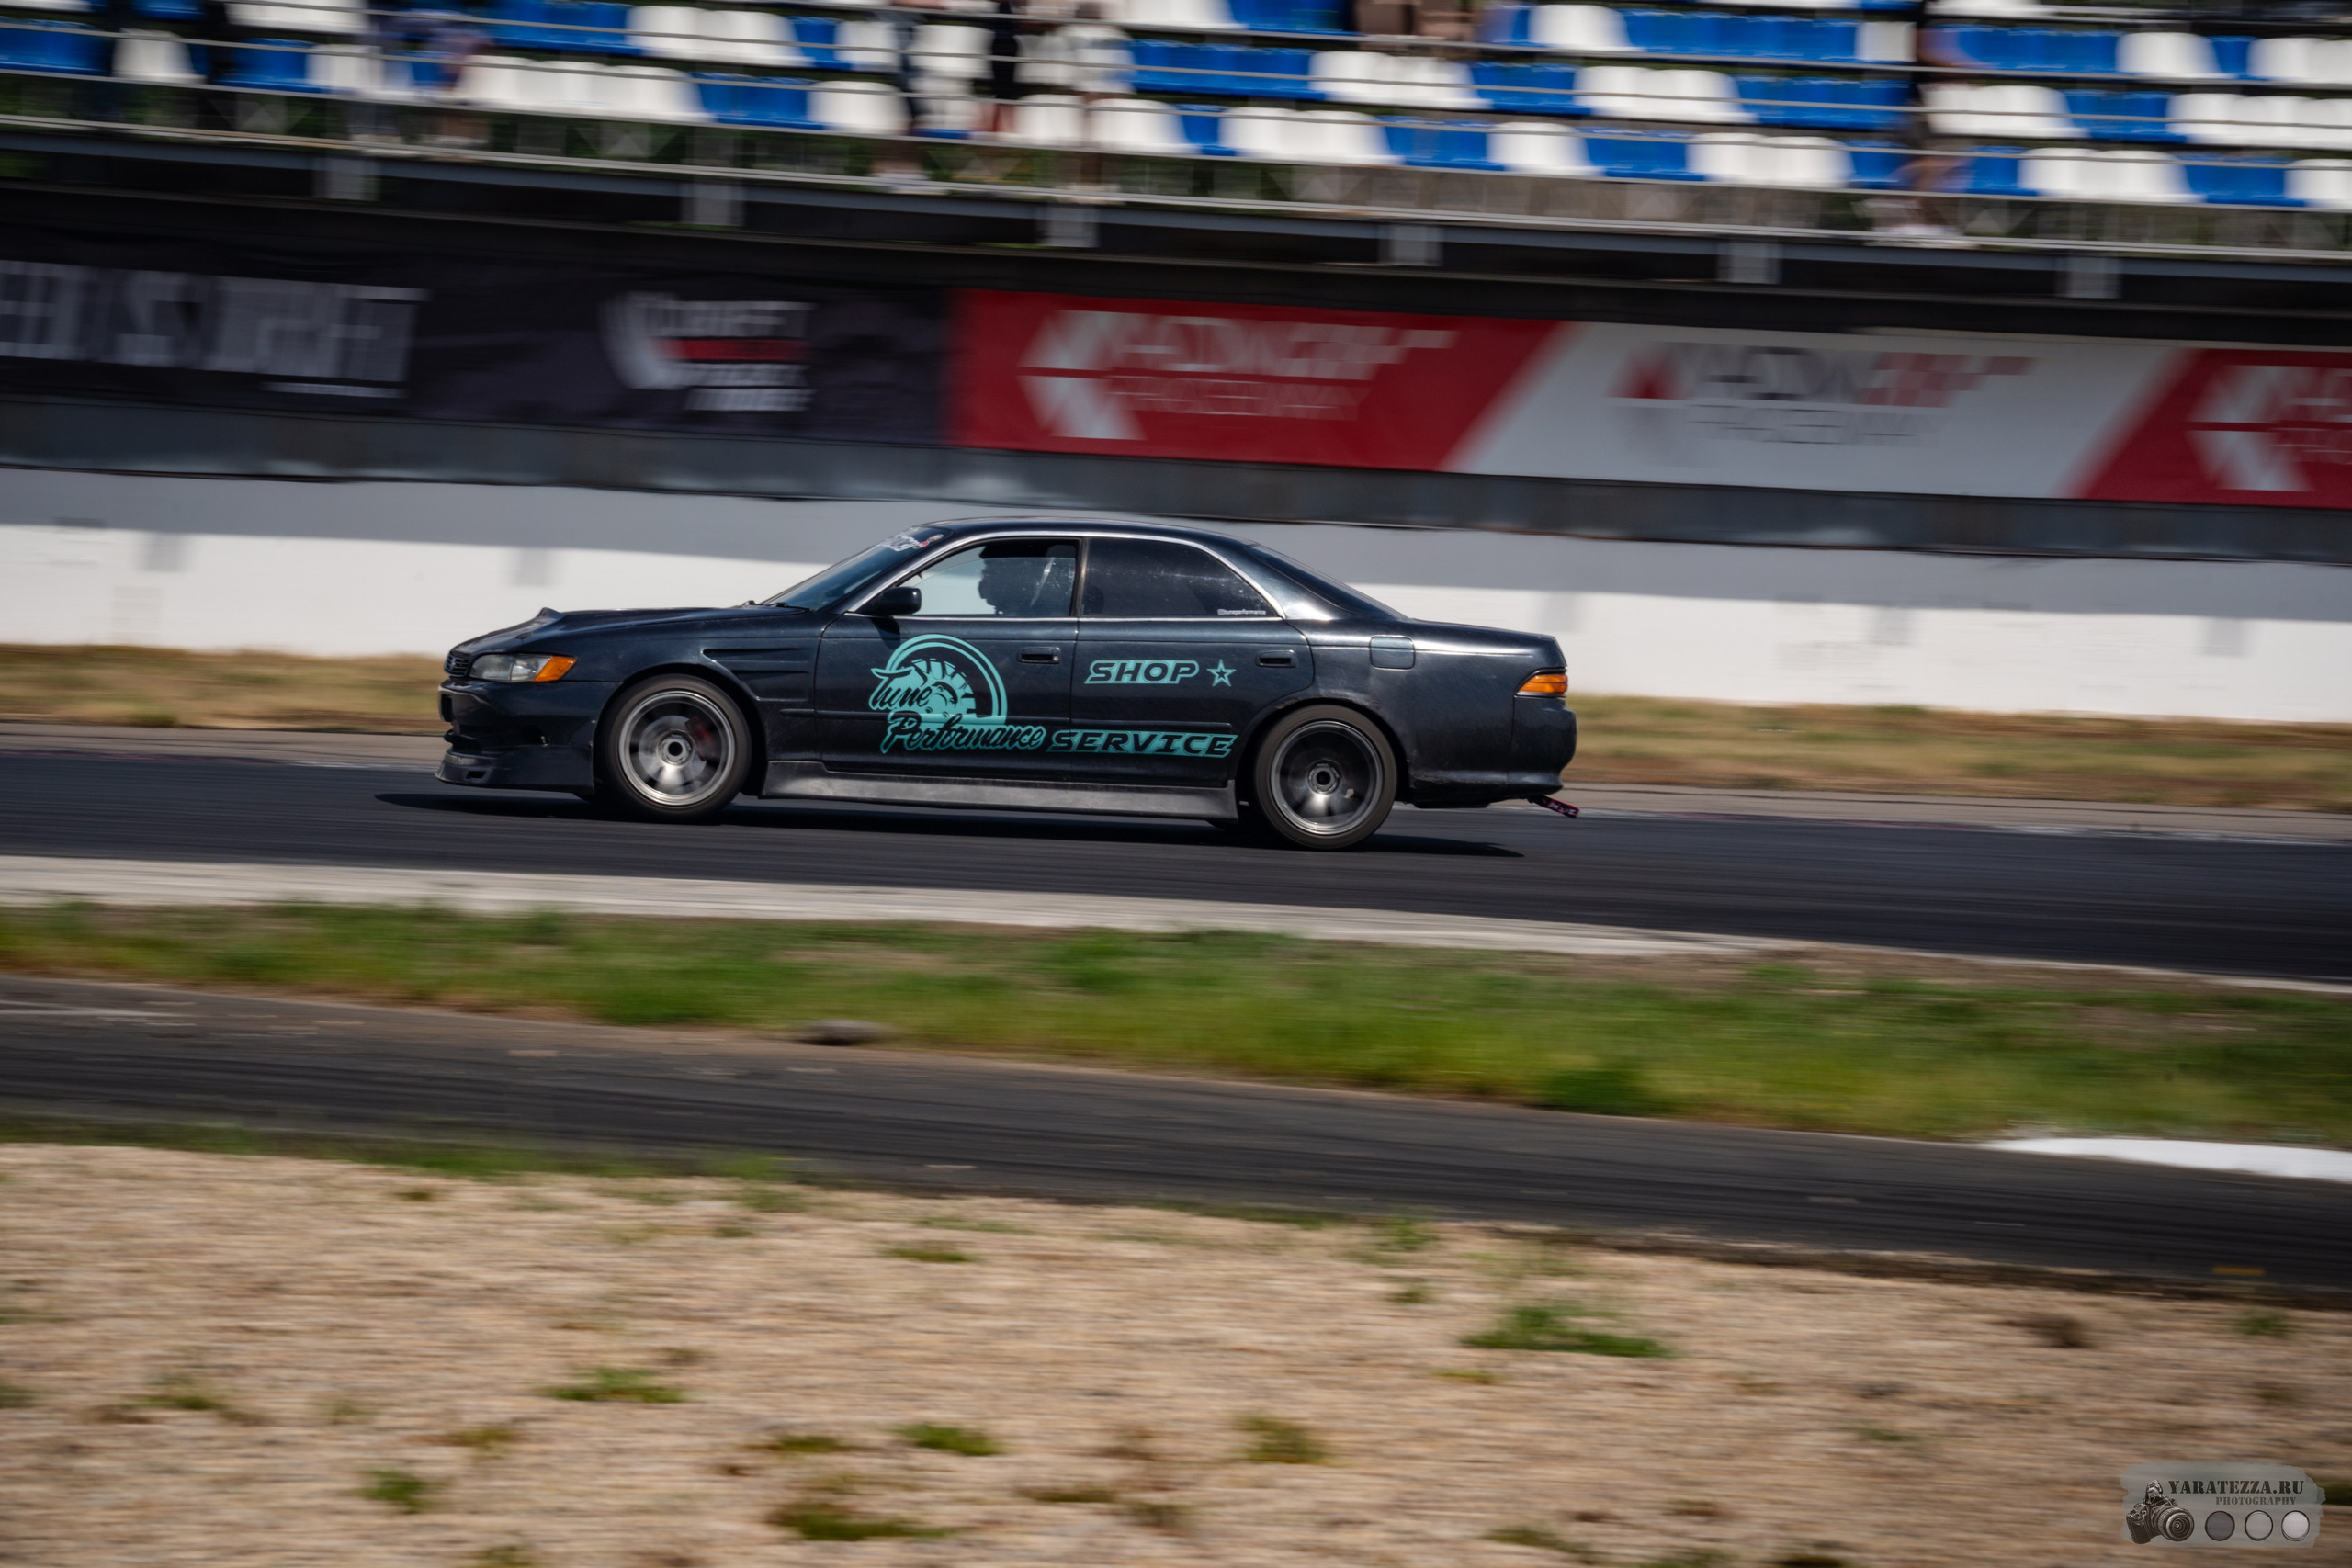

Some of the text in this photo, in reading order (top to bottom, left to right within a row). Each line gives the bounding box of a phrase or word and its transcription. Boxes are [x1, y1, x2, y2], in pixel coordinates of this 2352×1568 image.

[1086, 660, 1198, 683] SHOP
[871, 669, 932, 709] Tune
[881, 710, 1045, 752] Performance
[1047, 729, 1237, 758] SERVICE
